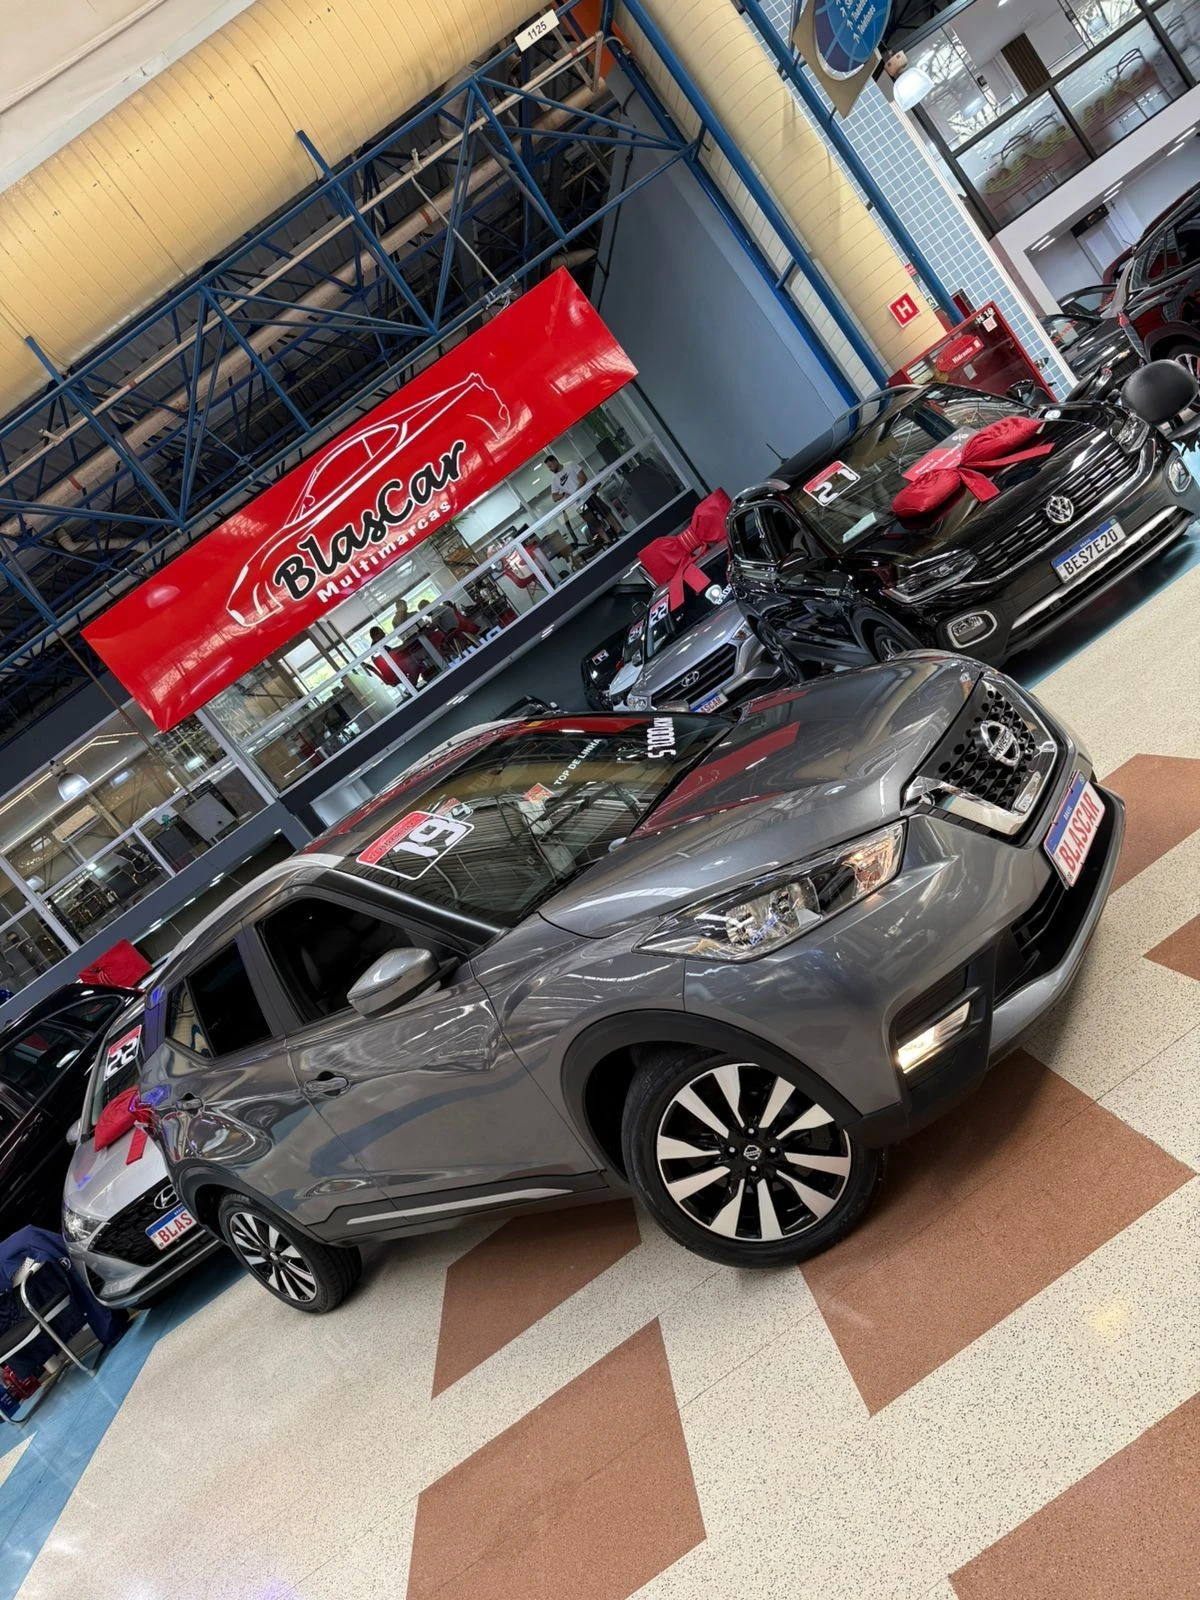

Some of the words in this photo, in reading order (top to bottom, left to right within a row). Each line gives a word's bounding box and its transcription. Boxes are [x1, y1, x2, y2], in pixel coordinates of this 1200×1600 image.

[527, 21, 547, 40] 1125
[896, 299, 914, 319] H
[813, 467, 857, 503] 21
[273, 440, 466, 600] BlasCar
[316, 500, 451, 603] Multimarcas
[1063, 529, 1118, 576] BES7E20
[650, 602, 668, 627] 22
[700, 696, 721, 713] ASCAR
[553, 770, 569, 786] TOP
[568, 759, 581, 770] DE
[578, 738, 602, 759] LINHA
[392, 818, 467, 857] 19
[1059, 791, 1100, 874] BLASCAR
[107, 1038, 138, 1077] 22
[157, 1213, 192, 1243] BLAS
